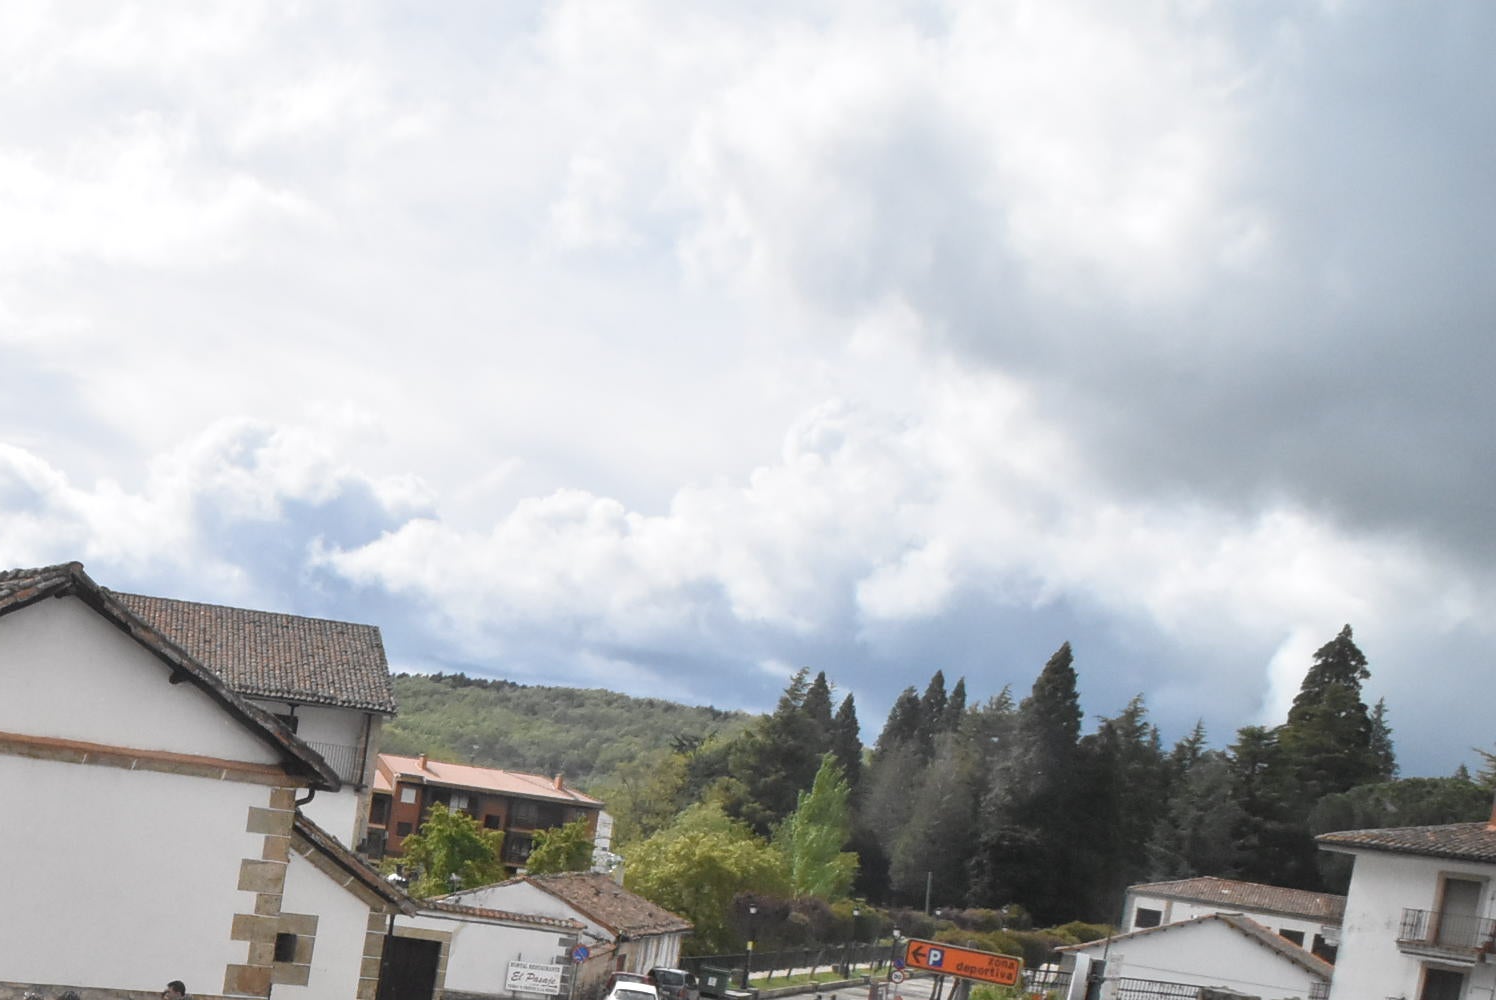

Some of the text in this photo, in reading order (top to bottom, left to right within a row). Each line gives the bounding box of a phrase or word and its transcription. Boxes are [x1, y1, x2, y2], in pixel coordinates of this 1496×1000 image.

[956, 962, 1013, 980] deportiva
[988, 957, 1015, 970] zona
[511, 971, 557, 986] El Pasaje
